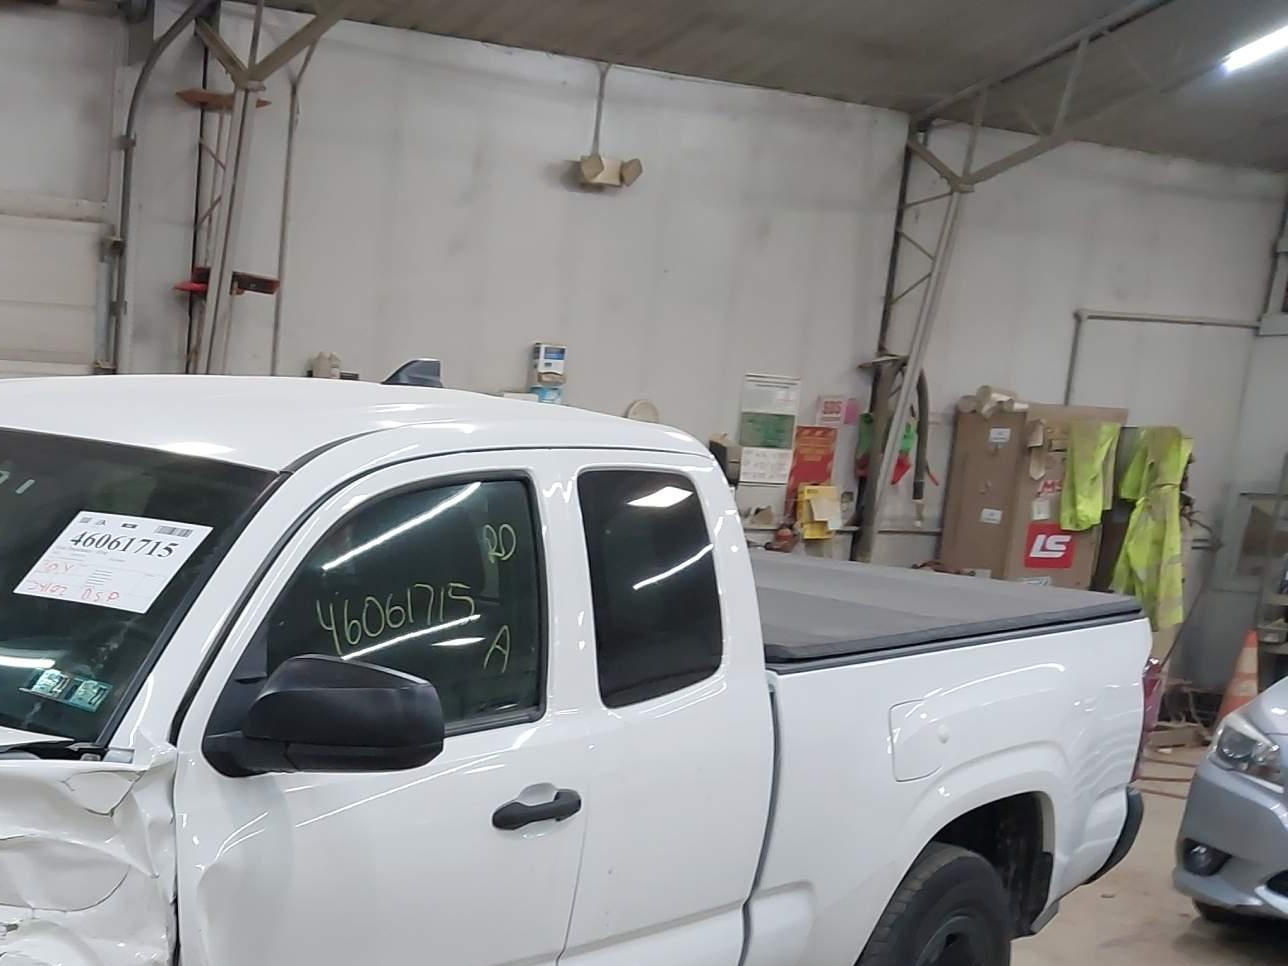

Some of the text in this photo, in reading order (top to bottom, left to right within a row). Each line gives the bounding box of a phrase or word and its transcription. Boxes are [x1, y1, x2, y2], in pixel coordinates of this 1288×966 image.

[70, 531, 180, 558] 46061715
[316, 583, 476, 656] 46061715
[483, 625, 511, 673] A
